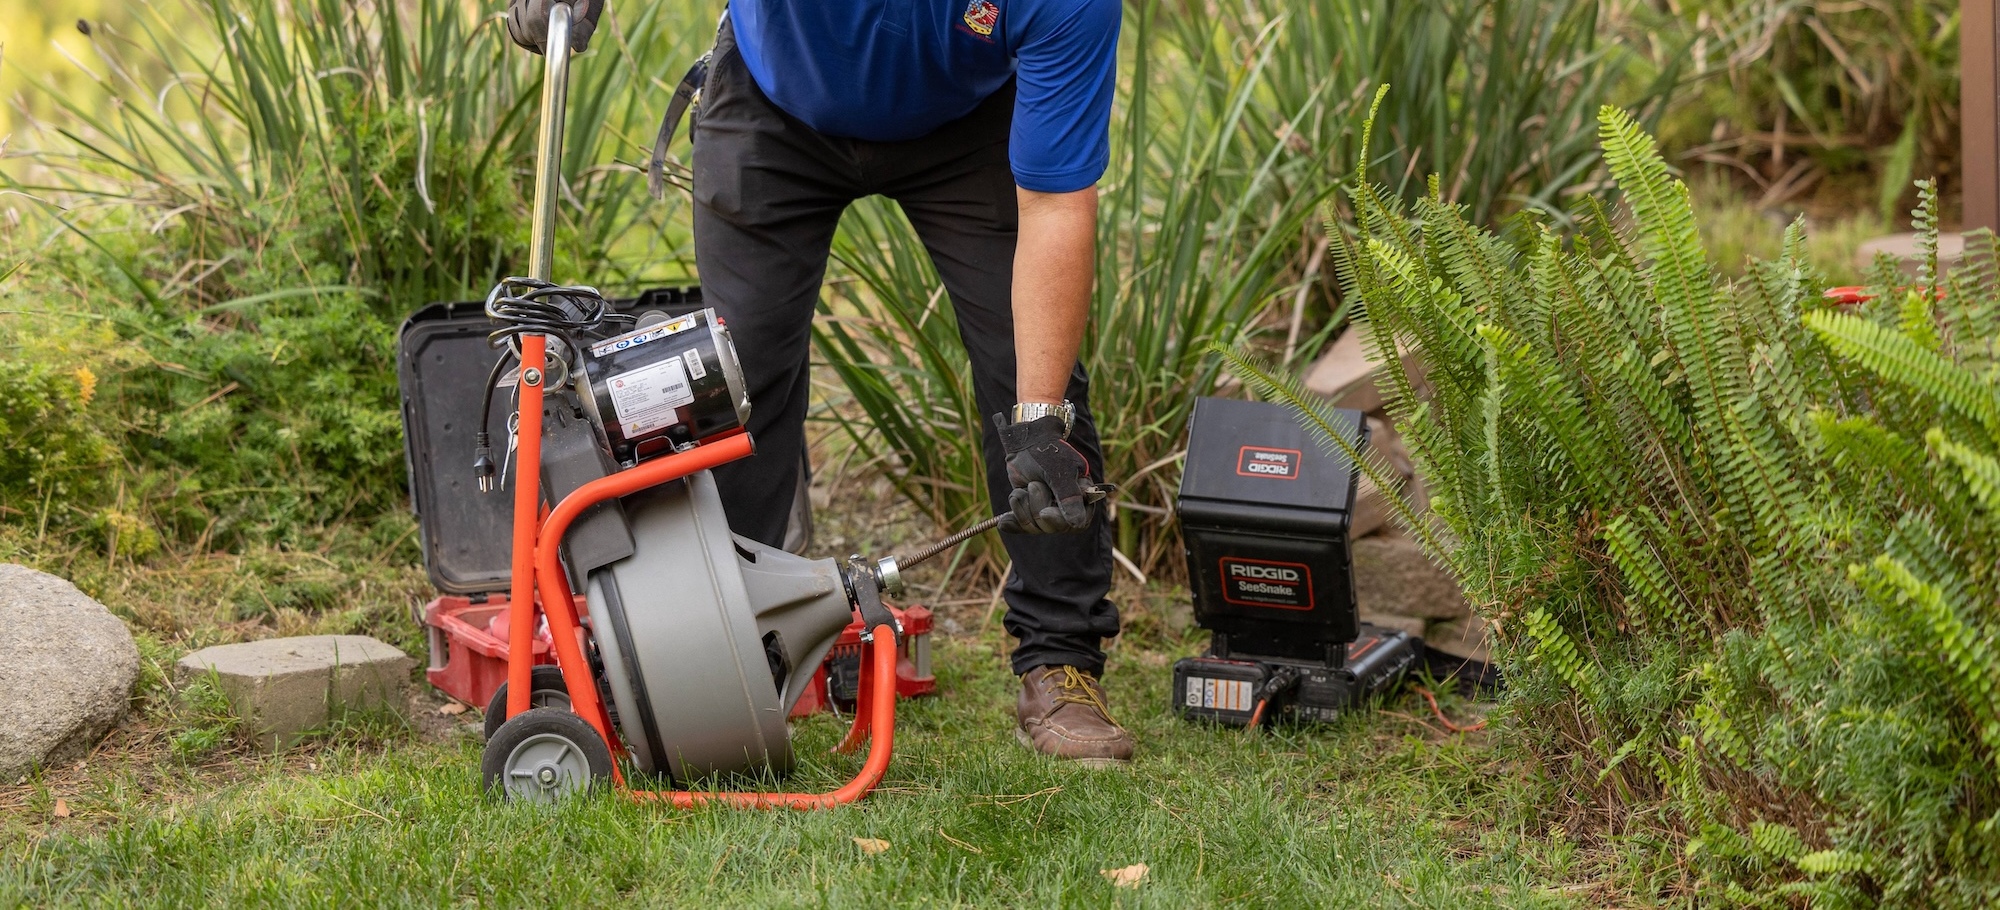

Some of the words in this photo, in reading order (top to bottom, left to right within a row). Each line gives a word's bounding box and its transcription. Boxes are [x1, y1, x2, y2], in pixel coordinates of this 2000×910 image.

[1248, 463, 1289, 474] RIDGID
[1230, 564, 1299, 581] RIDGID
[1239, 581, 1293, 596] SeeSnake
